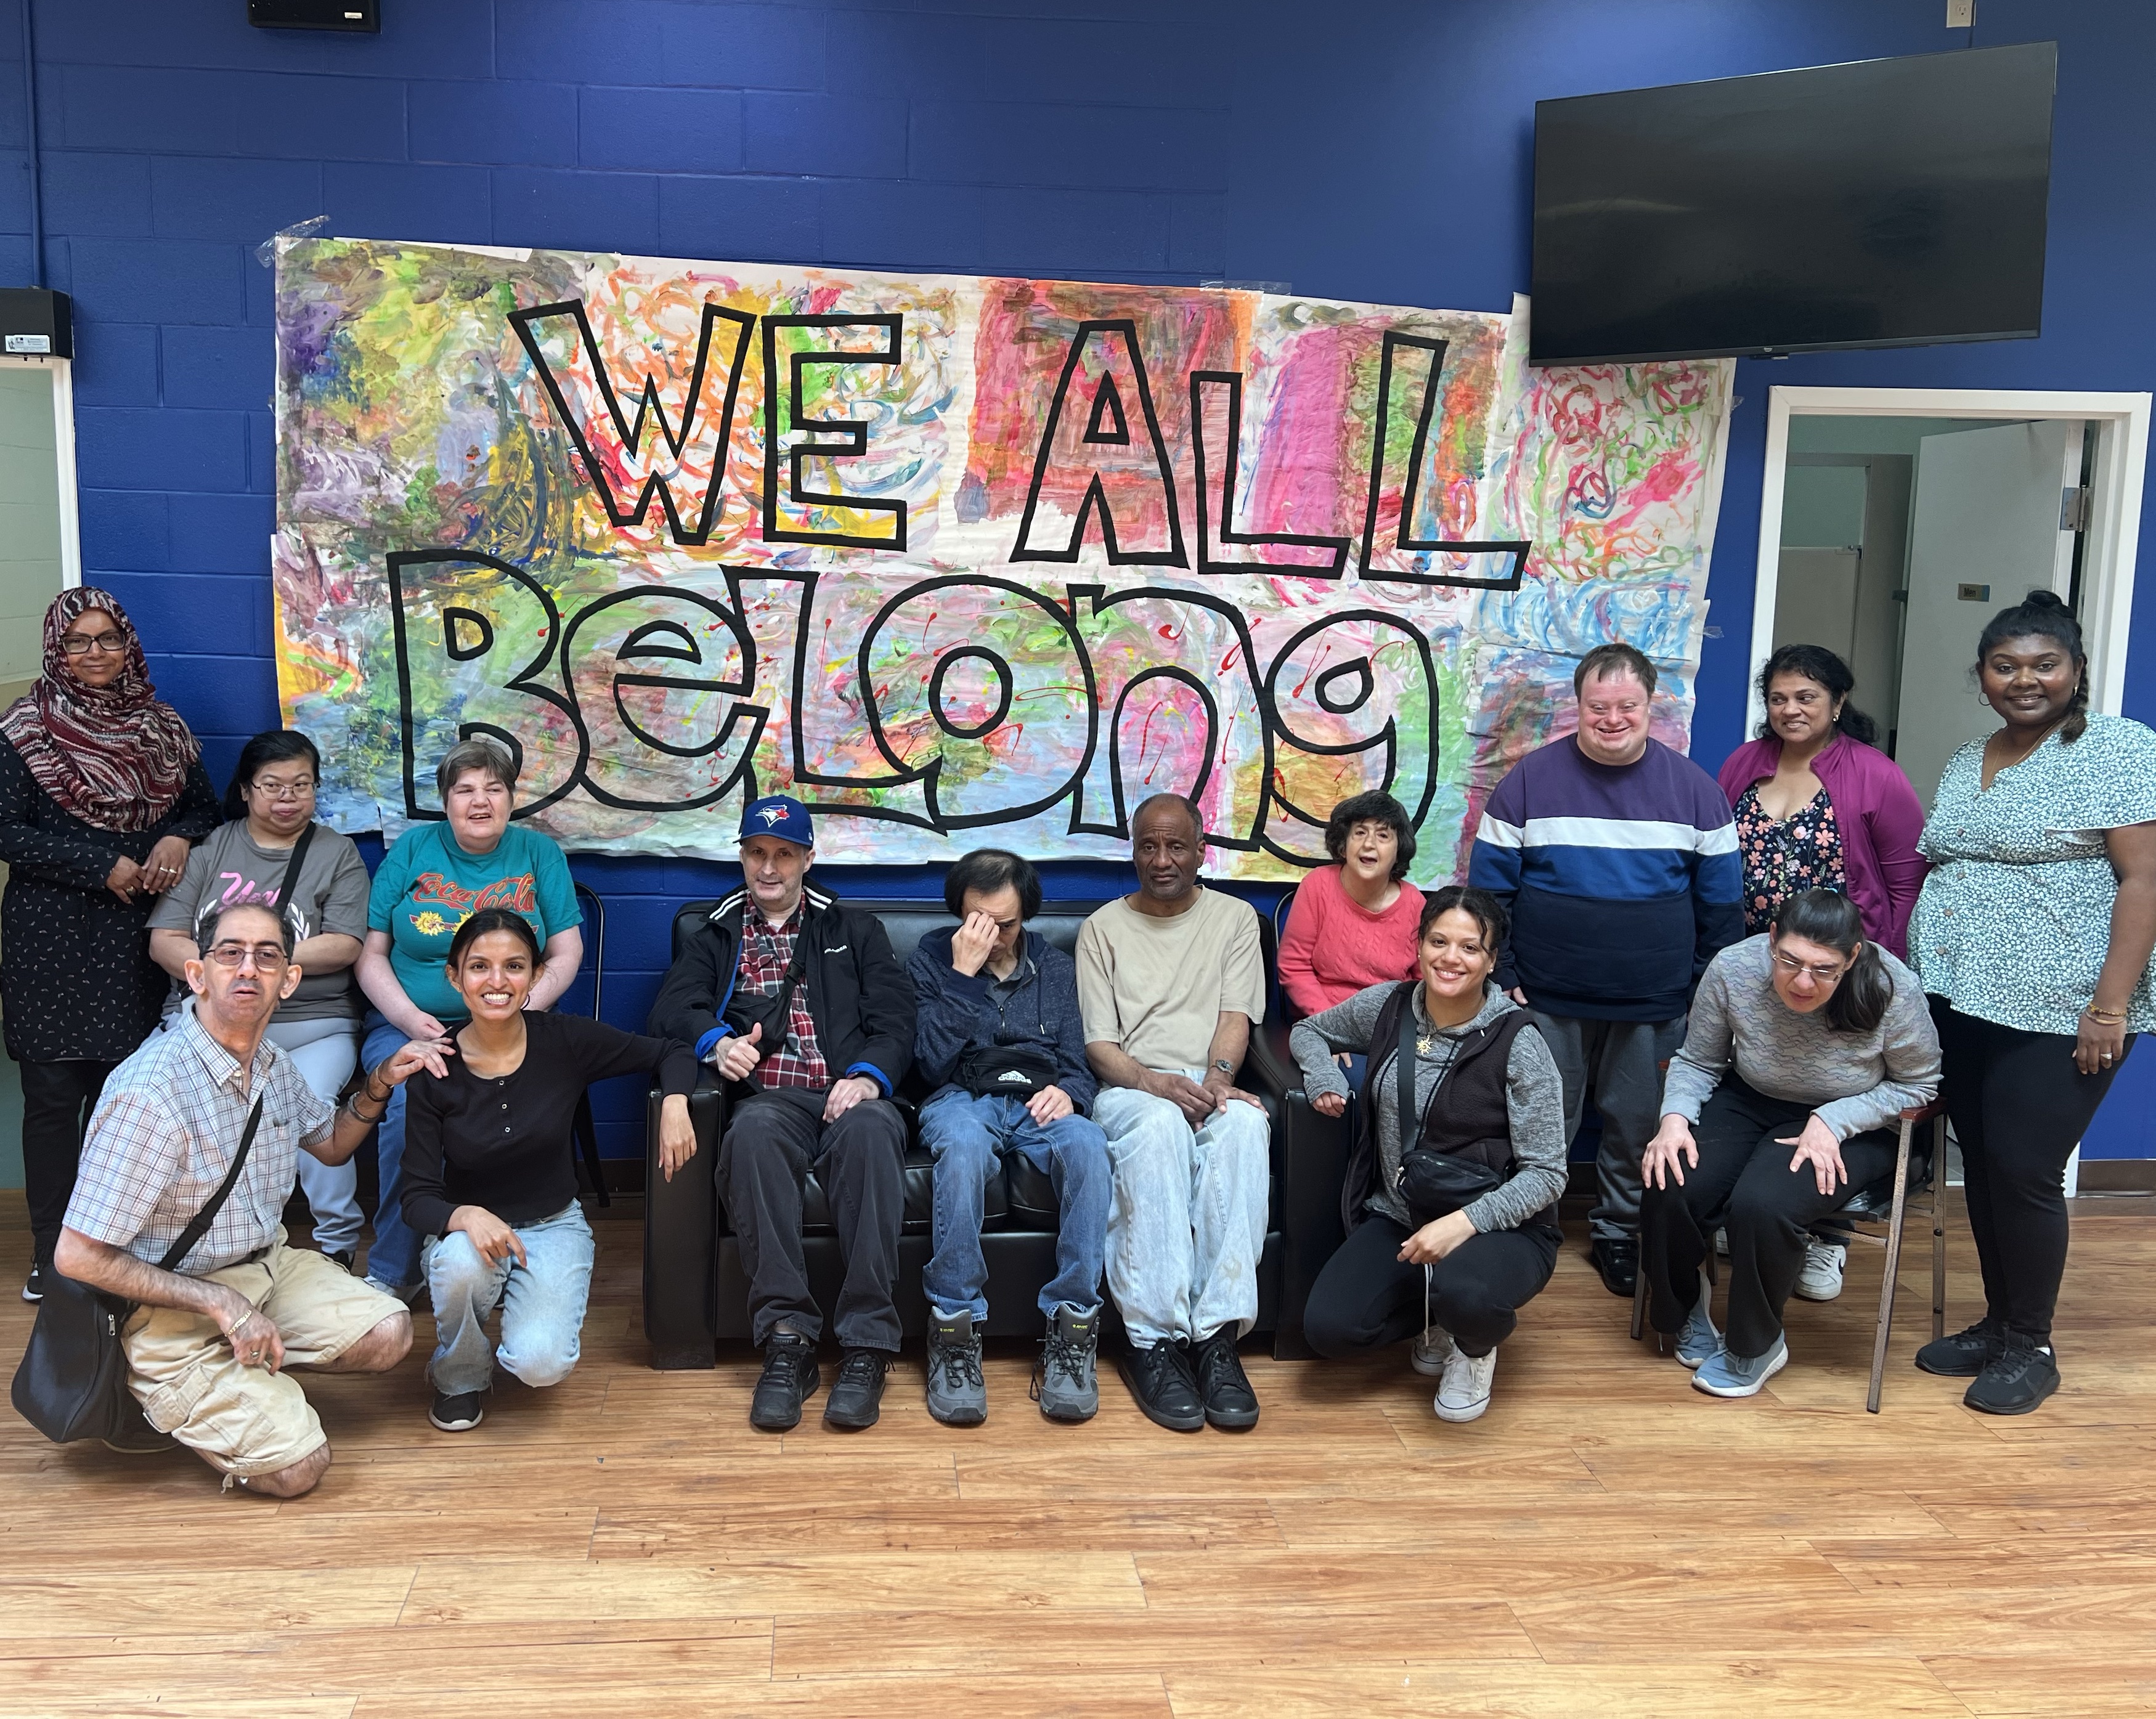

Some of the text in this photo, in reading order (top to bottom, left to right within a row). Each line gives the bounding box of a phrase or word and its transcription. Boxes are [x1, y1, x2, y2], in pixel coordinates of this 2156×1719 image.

[507, 299, 1532, 591] WE ALL
[998, 1074, 1032, 1084] adidas
